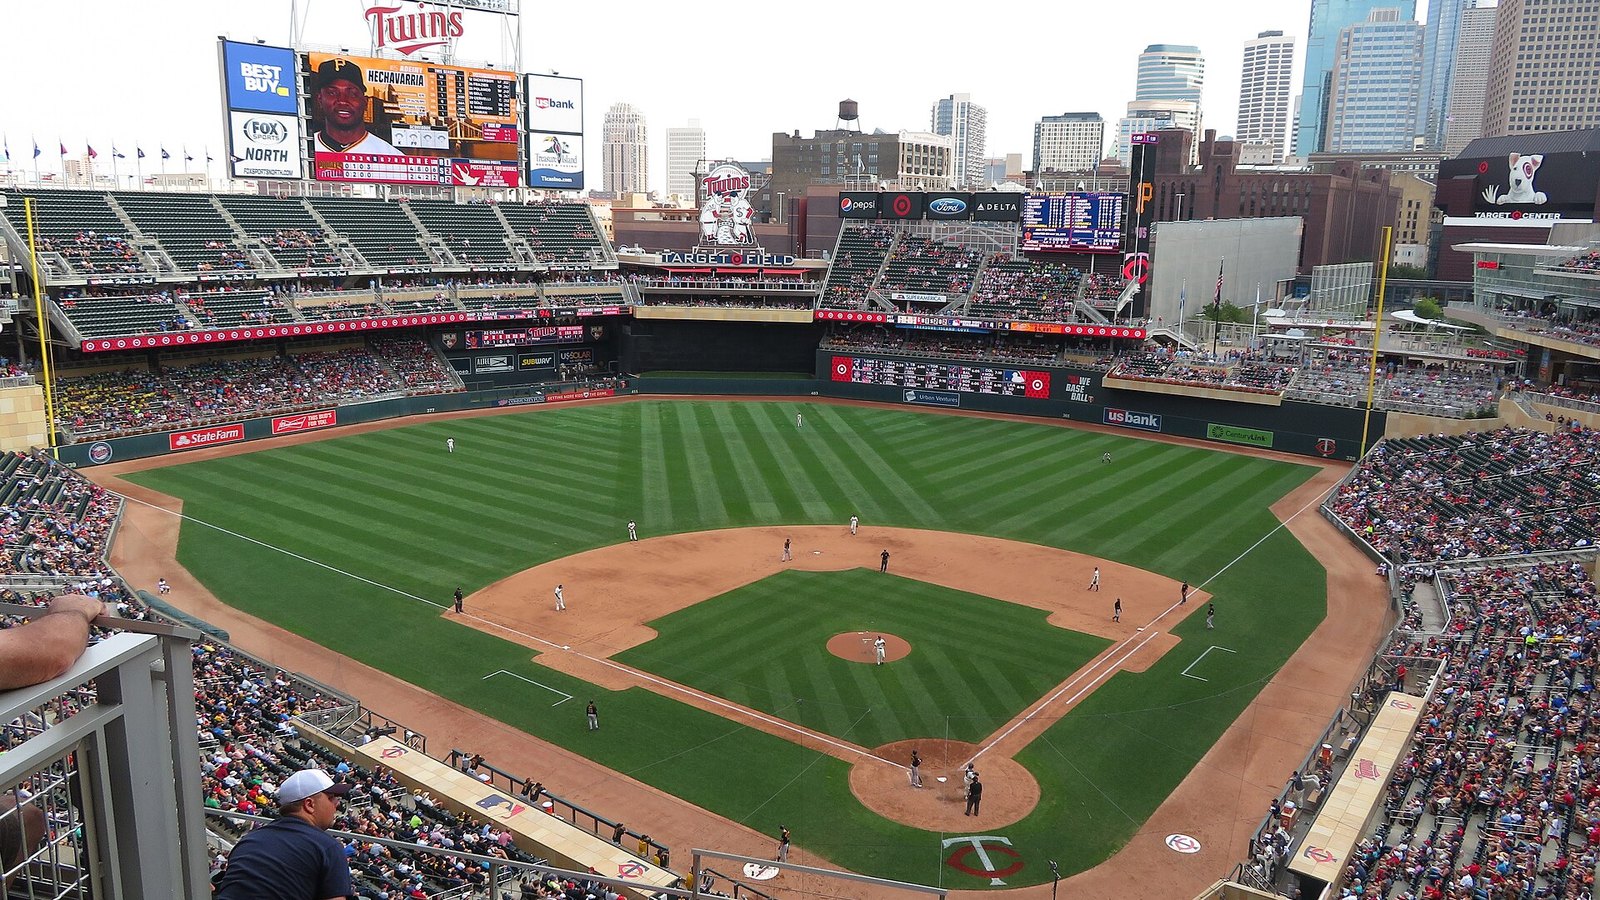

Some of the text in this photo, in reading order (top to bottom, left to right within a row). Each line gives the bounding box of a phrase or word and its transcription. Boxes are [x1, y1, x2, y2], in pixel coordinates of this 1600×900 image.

[364, 3, 464, 48] Twins
[241, 62, 282, 80] BEST
[368, 70, 424, 86] HECHAVARRIA
[245, 77, 279, 94] BUY
[252, 122, 278, 135] FOX
[246, 147, 288, 162] NORTH
[536, 153, 577, 164] Treasure Island
[243, 168, 293, 176] FOXSPORTSNORTH.COM
[703, 174, 750, 195] Twins
[853, 200, 875, 210] pepsi
[937, 201, 959, 211] Ford
[664, 253, 795, 265] TARGET FIELD
[528, 327, 556, 337] Twins
[1079, 377, 1091, 385] WE
[1066, 384, 1085, 393] BASE
[1071, 392, 1088, 402] BALL
[1109, 411, 1157, 427] usbank
[1226, 431, 1266, 441] CenturyLink
